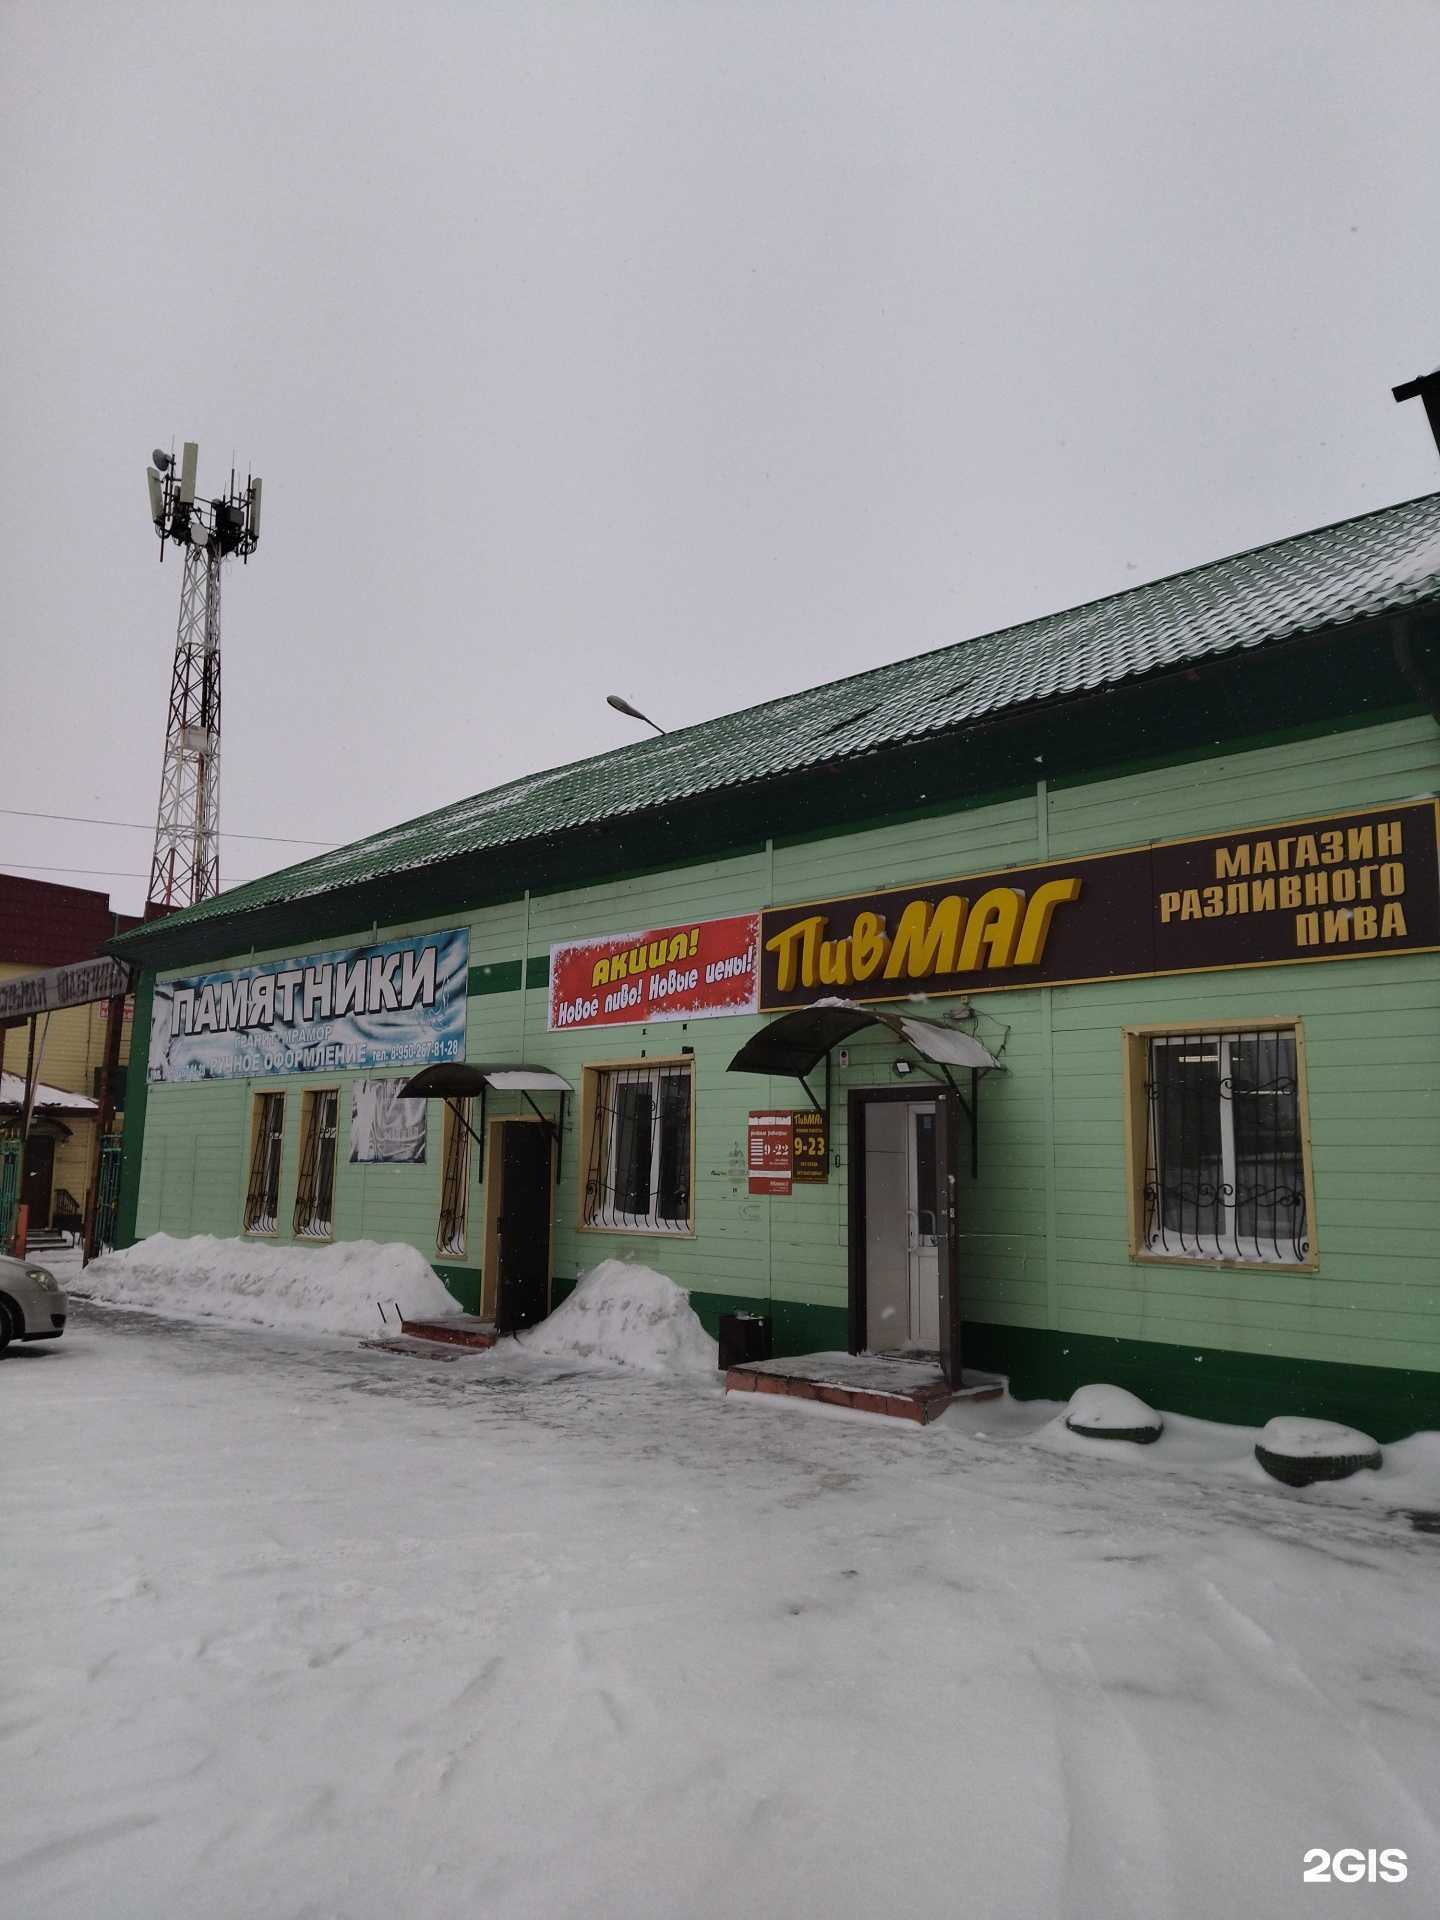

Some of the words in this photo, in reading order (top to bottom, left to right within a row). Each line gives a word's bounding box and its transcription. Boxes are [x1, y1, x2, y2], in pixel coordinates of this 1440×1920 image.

[1215, 821, 1403, 879] МАГАЗИН
[1159, 862, 1405, 923] РАЗЛИВНОГО
[766, 877, 1082, 992] ПивМАГ
[1296, 902, 1408, 946] ПИВА
[170, 946, 437, 1037] ПАМЯТНИКИ
[557, 995, 599, 1026] Новое
[604, 978, 643, 1014] пиво!
[648, 967, 698, 1001] Новые
[705, 945, 753, 984] цены!
[210, 1053, 261, 1074] РУЧНОЕ
[263, 1044, 367, 1071] ОФОРМЛЕНИЕ
[234, 1032, 276, 1049] ГРАНИТ
[794, 1137, 825, 1156] 9-23
